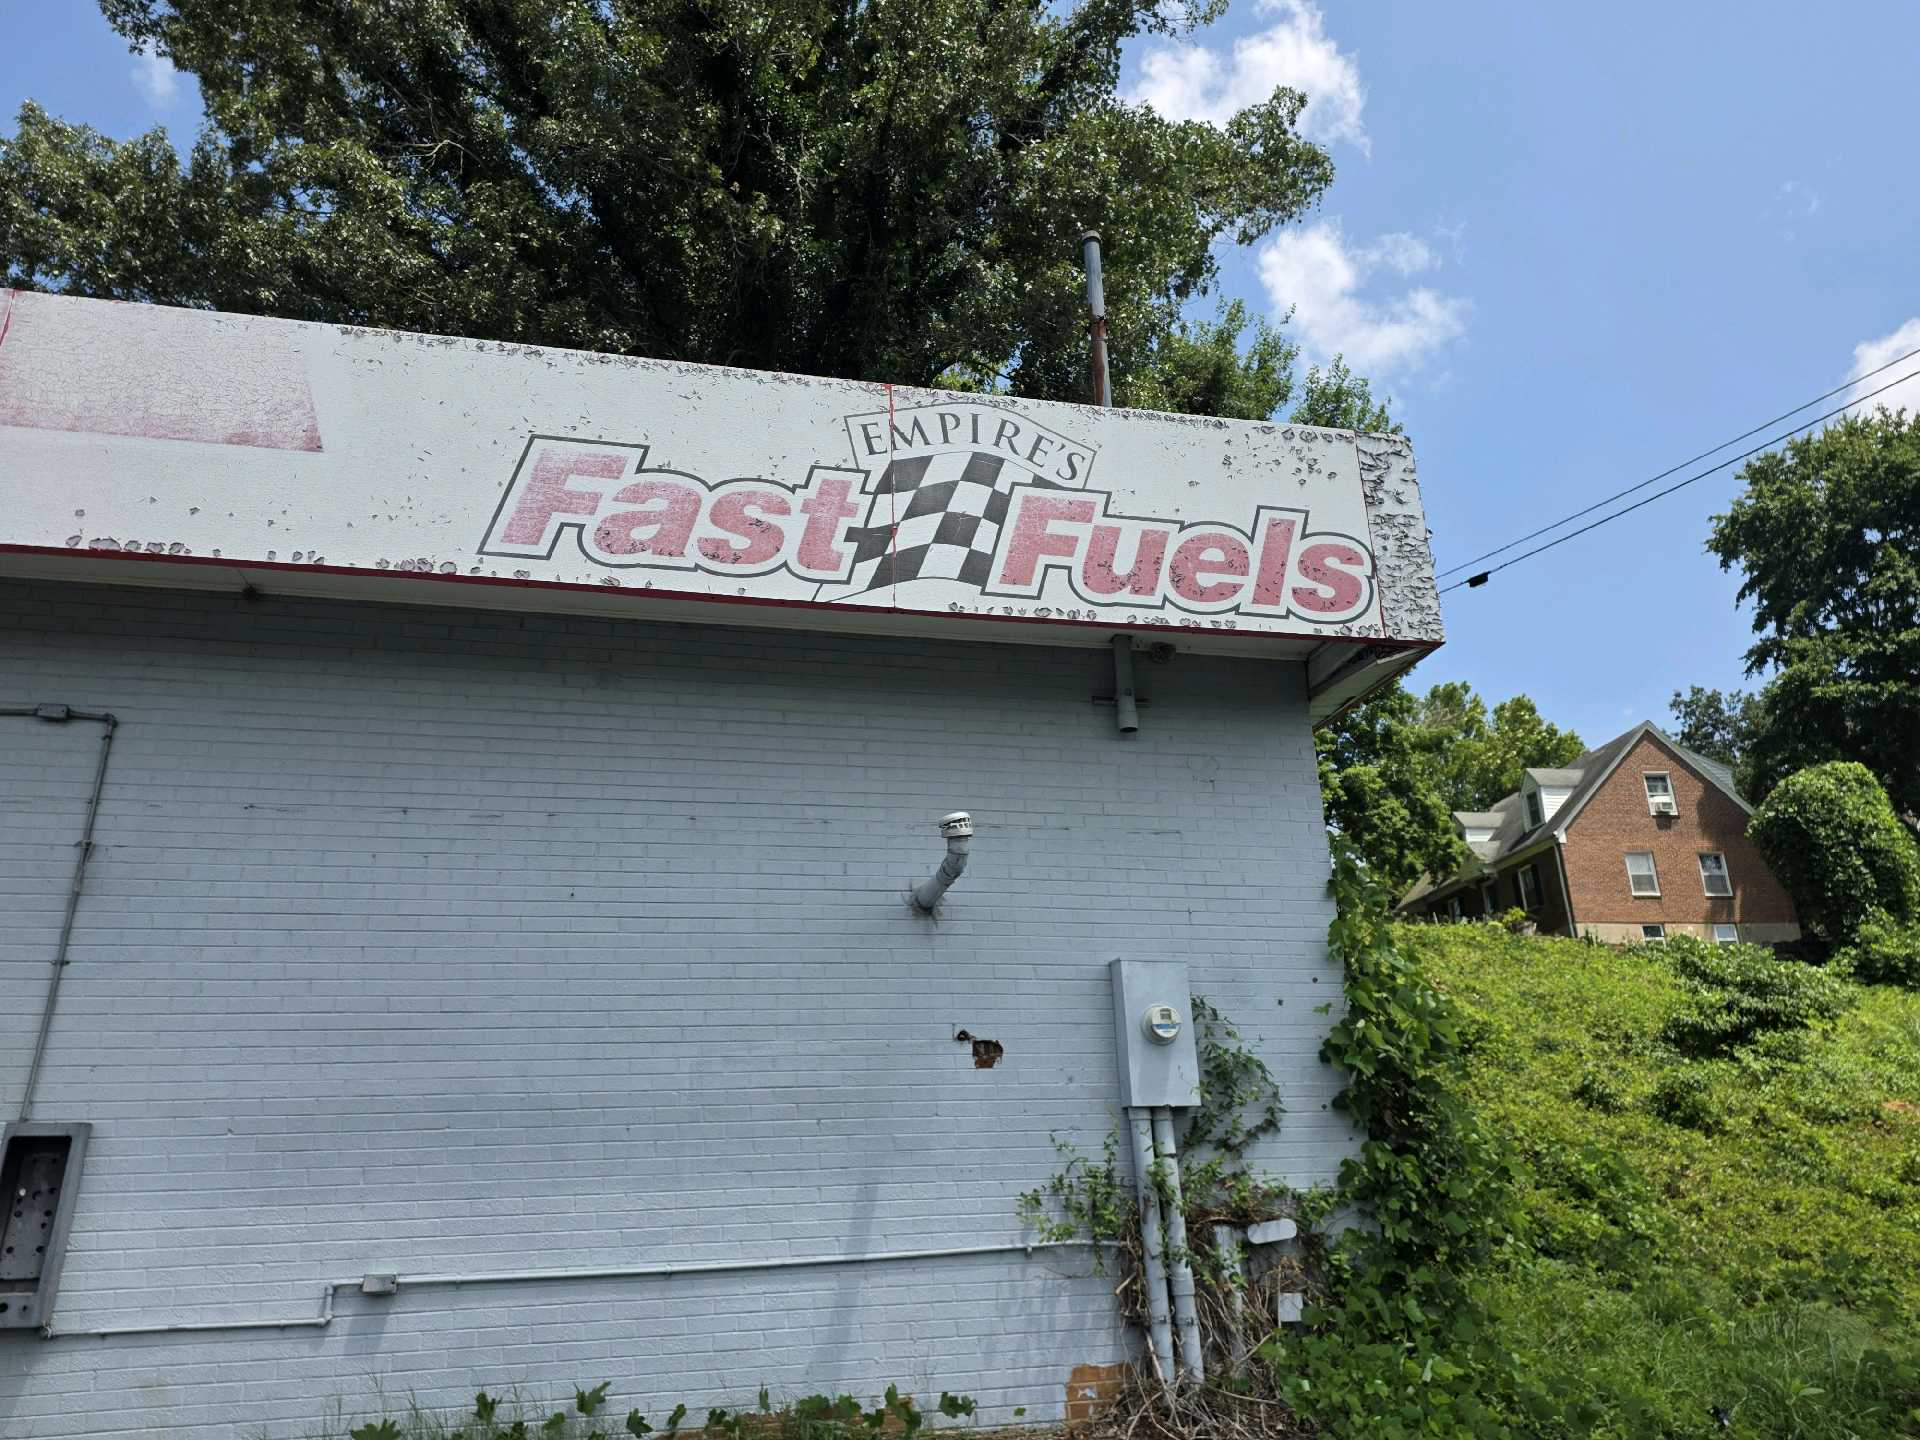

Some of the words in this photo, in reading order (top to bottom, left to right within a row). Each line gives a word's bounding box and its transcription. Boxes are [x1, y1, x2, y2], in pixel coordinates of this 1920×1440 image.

[861, 413, 1086, 481] EMPIRE'S
[501, 448, 860, 573] Fast
[999, 495, 1364, 613] Fuels
